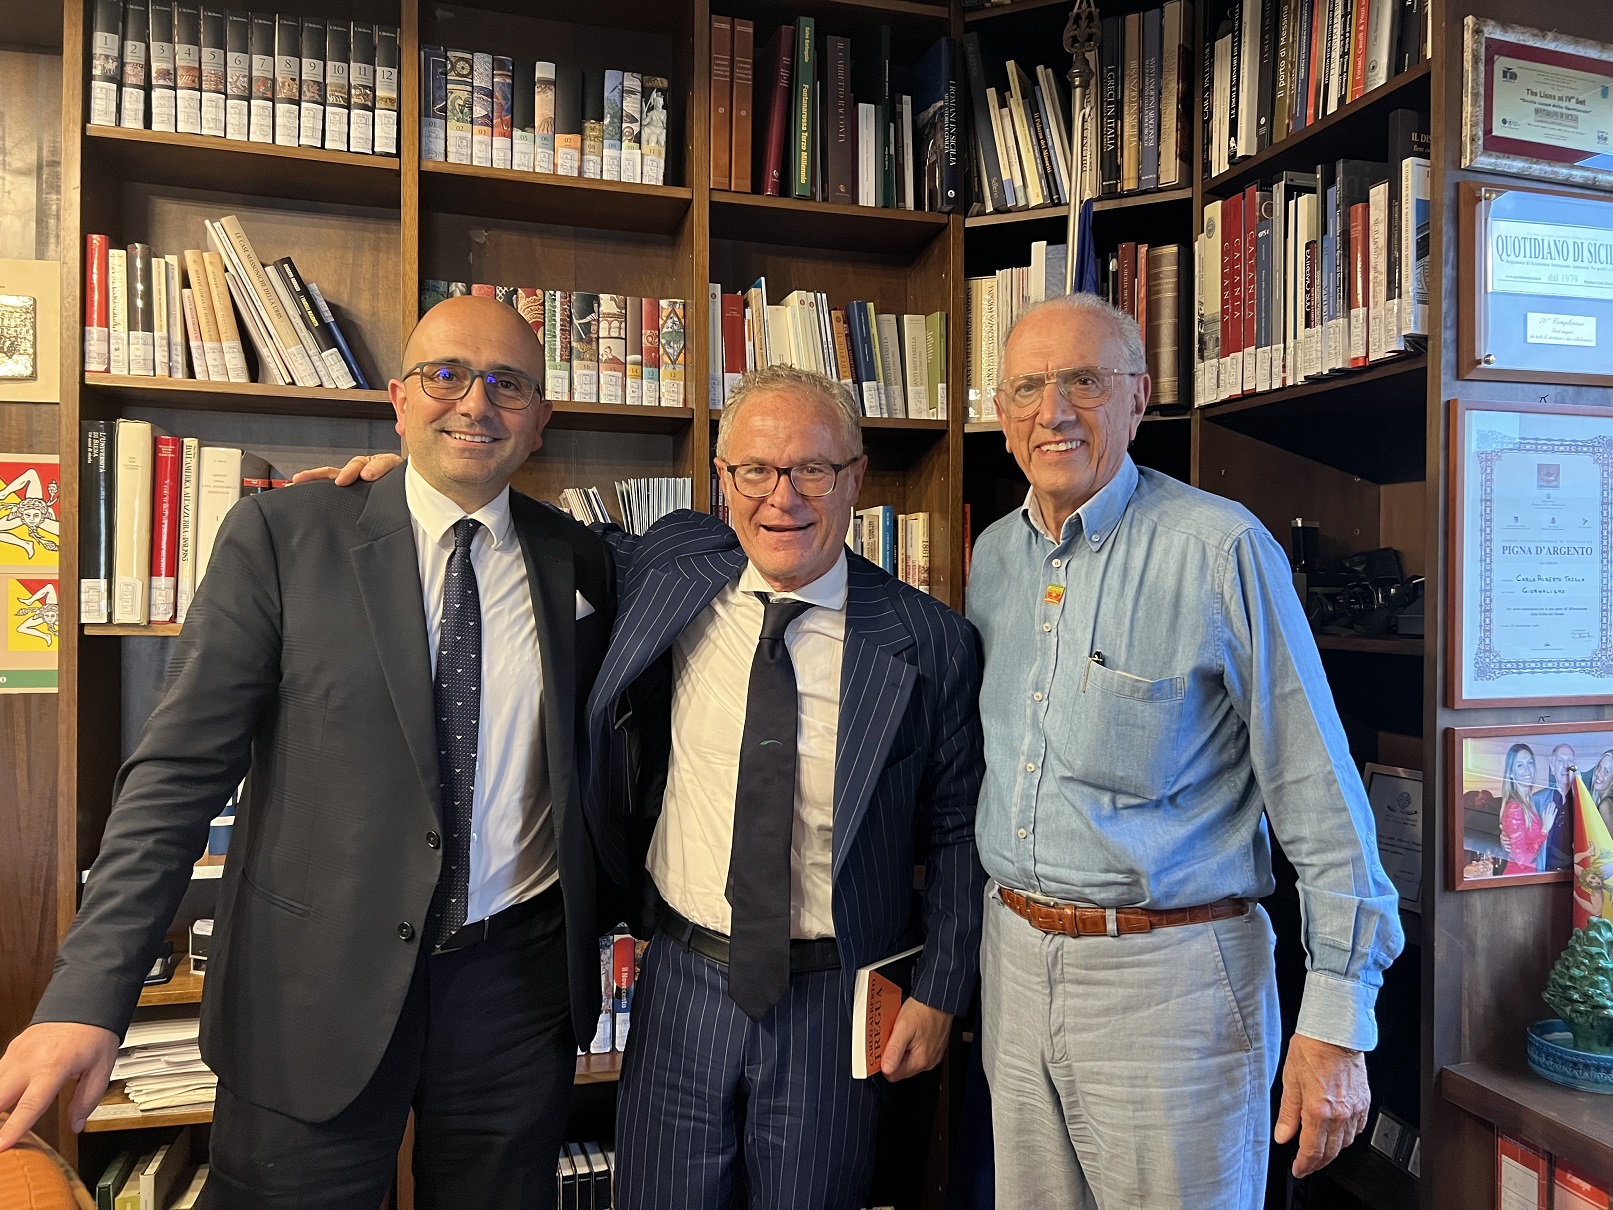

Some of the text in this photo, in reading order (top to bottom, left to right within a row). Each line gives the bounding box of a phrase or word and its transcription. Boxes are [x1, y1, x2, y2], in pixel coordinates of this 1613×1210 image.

[1279, 5, 1289, 46] Messina
[103, 36, 108, 46] 1
[130, 44, 137, 54] 2
[159, 45, 165, 55] 3
[184, 48, 191, 58] 4
[1279, 48, 1287, 58] di
[209, 51, 216, 61] 5
[234, 55, 241, 65] 6
[259, 58, 266, 68] 7
[285, 59, 292, 69] 8
[309, 62, 316, 72] 9
[1202, 42, 1210, 89] PALERMO
[333, 65, 344, 75] 10
[358, 66, 367, 77] 11
[382, 70, 393, 81] 12
[837, 52, 845, 99] CARRETTO
[1278, 60, 1287, 88] porto
[1107, 72, 1115, 102] GRECI
[1525, 88, 1538, 98] The
[1539, 90, 1557, 101] Lions
[1129, 60, 1138, 147] BISANZIO IN SICILIA
[1107, 104, 1115, 116] IN
[1167, 87, 1175, 140] NORMANNI
[800, 83, 810, 184] Fontanarossa Terzo Millennio
[949, 123, 956, 134] IN
[1107, 119, 1115, 152] ITALIA
[1411, 132, 1419, 142] IL
[949, 134, 957, 166] SICILIA
[1496, 234, 1570, 262] QUOTIDIANO
[1572, 240, 1585, 263] DI
[238, 239, 249, 253] CASE
[245, 253, 267, 288] MASSONICHE
[263, 287, 275, 305] DELLA
[1547, 273, 1559, 282] dal
[1561, 274, 1578, 283] 1979
[883, 336, 891, 372] MATTARELLA
[99, 432, 107, 473] L'UNIVERSITÀ
[182, 445, 193, 534] DALL'AMERICA ALL'AZZURRA
[1501, 545, 1593, 556] PIGNA D'ARGENTO
[621, 972, 629, 1009] Novecento
[874, 986, 883, 1064] TREGUA
